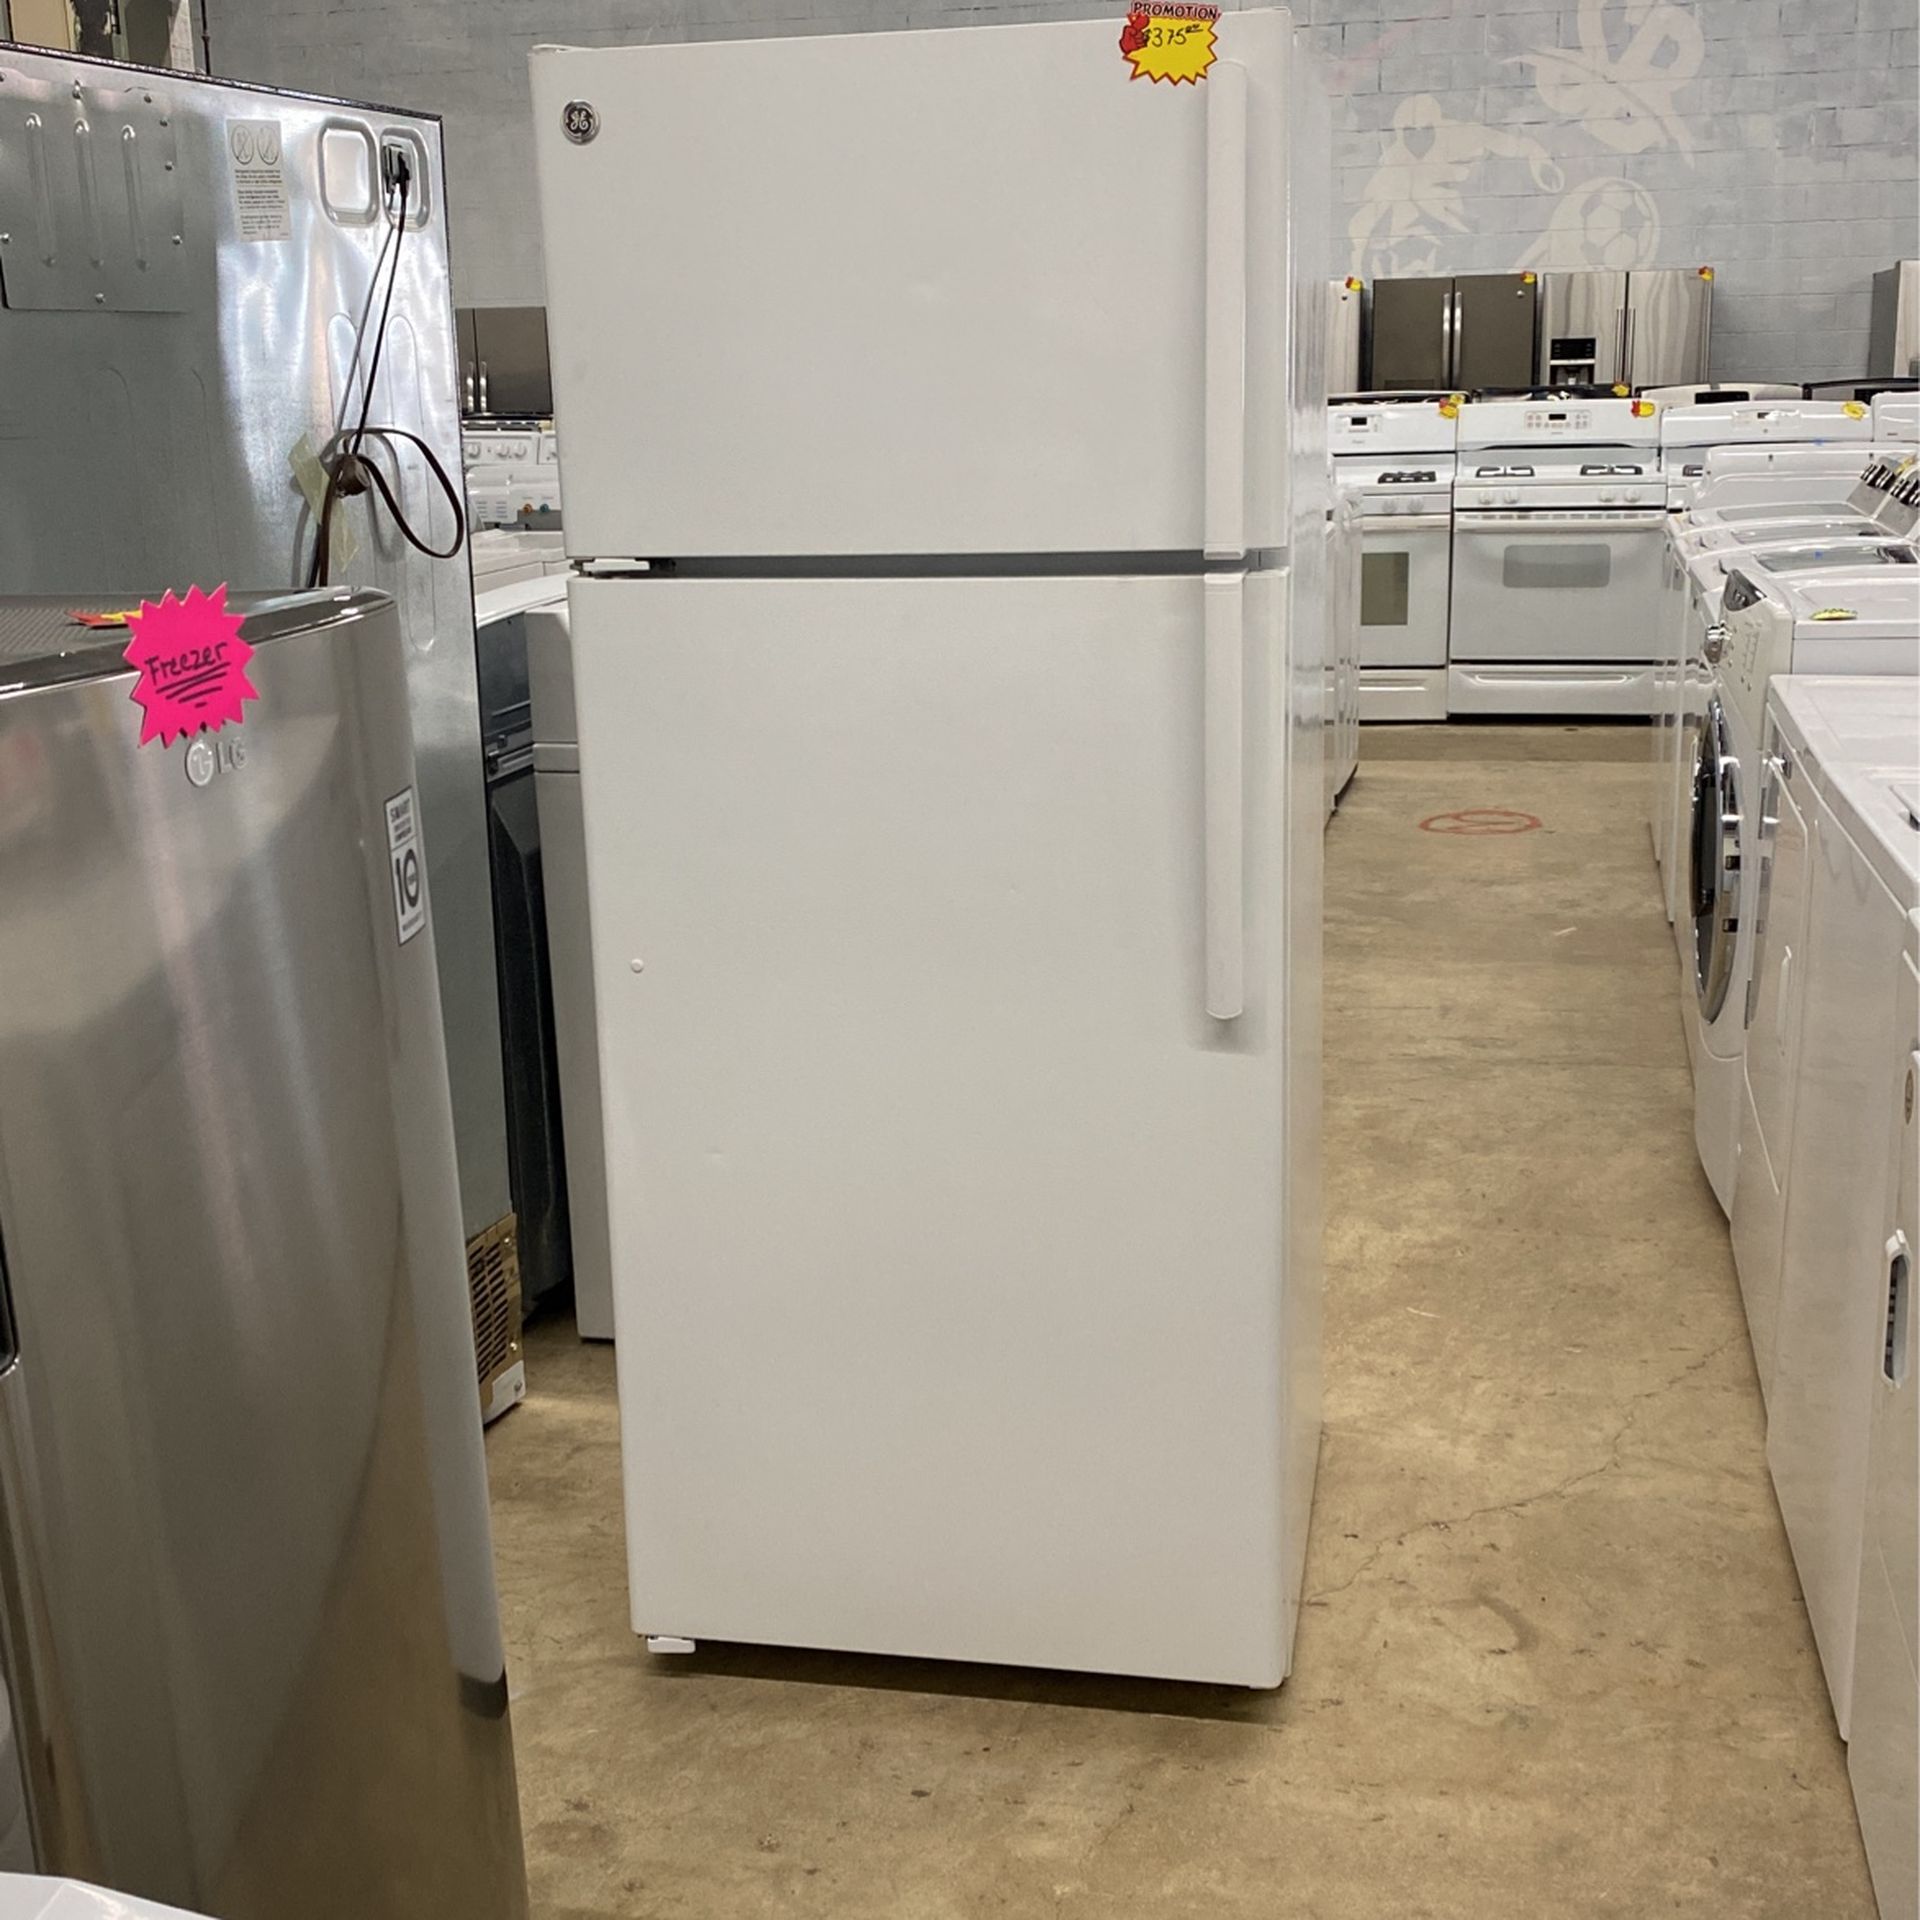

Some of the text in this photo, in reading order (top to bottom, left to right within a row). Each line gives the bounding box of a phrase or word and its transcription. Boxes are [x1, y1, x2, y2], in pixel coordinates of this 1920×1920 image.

[145, 642, 228, 686] Freezer
[216, 736, 248, 774] LG
[395, 848, 420, 916] 10
